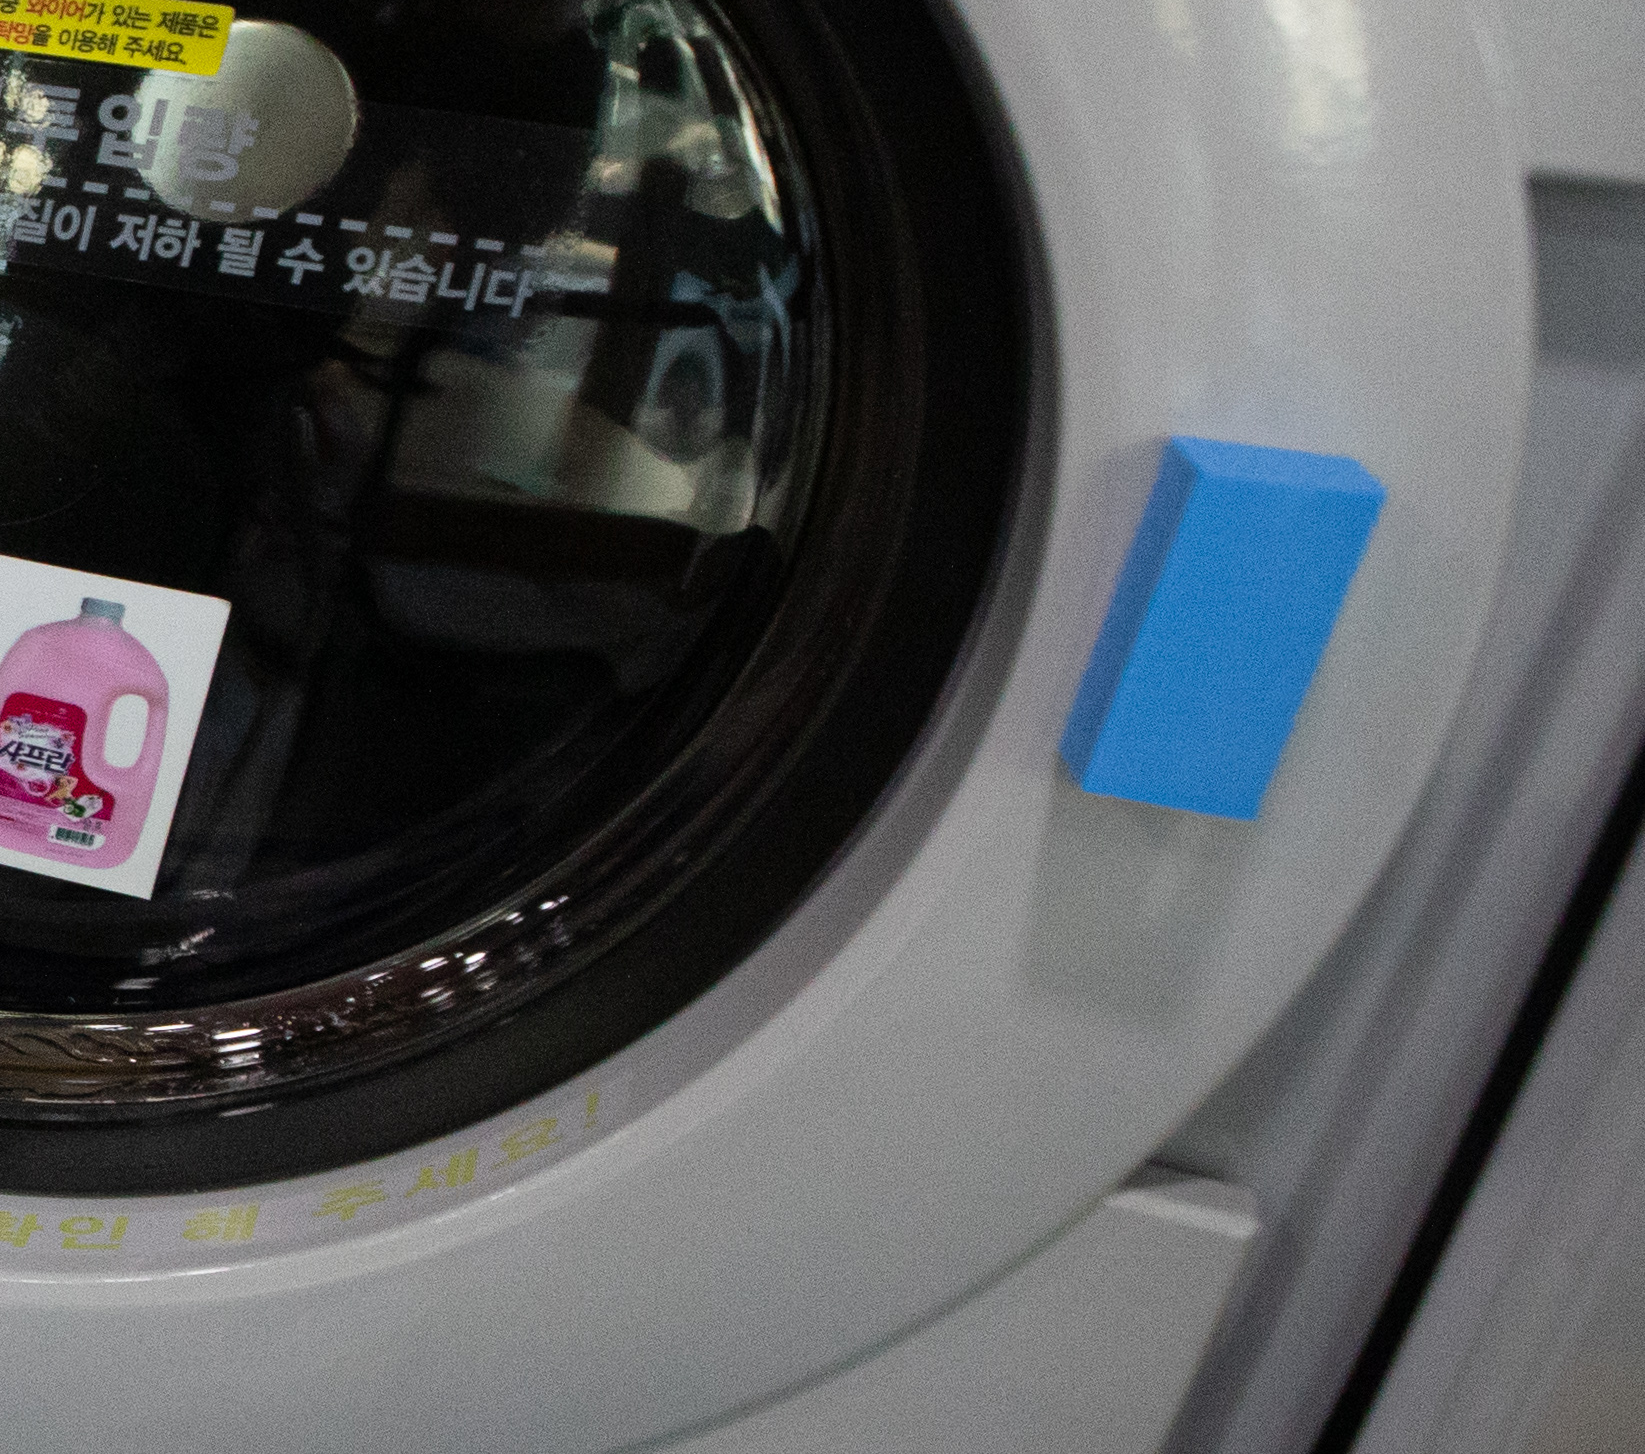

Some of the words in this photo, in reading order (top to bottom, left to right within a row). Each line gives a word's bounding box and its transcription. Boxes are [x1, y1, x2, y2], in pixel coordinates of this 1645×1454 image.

[112, 5, 151, 30] 있는
[156, 11, 220, 39] 제품은
[58, 29, 117, 55] 이용해
[123, 37, 187, 65] 주세요.
[110, 212, 201, 268] 저하
[218, 227, 264, 278] 될
[277, 238, 324, 284] 수
[342, 245, 535, 319] 있습니다
[181, 1202, 261, 1245] 해
